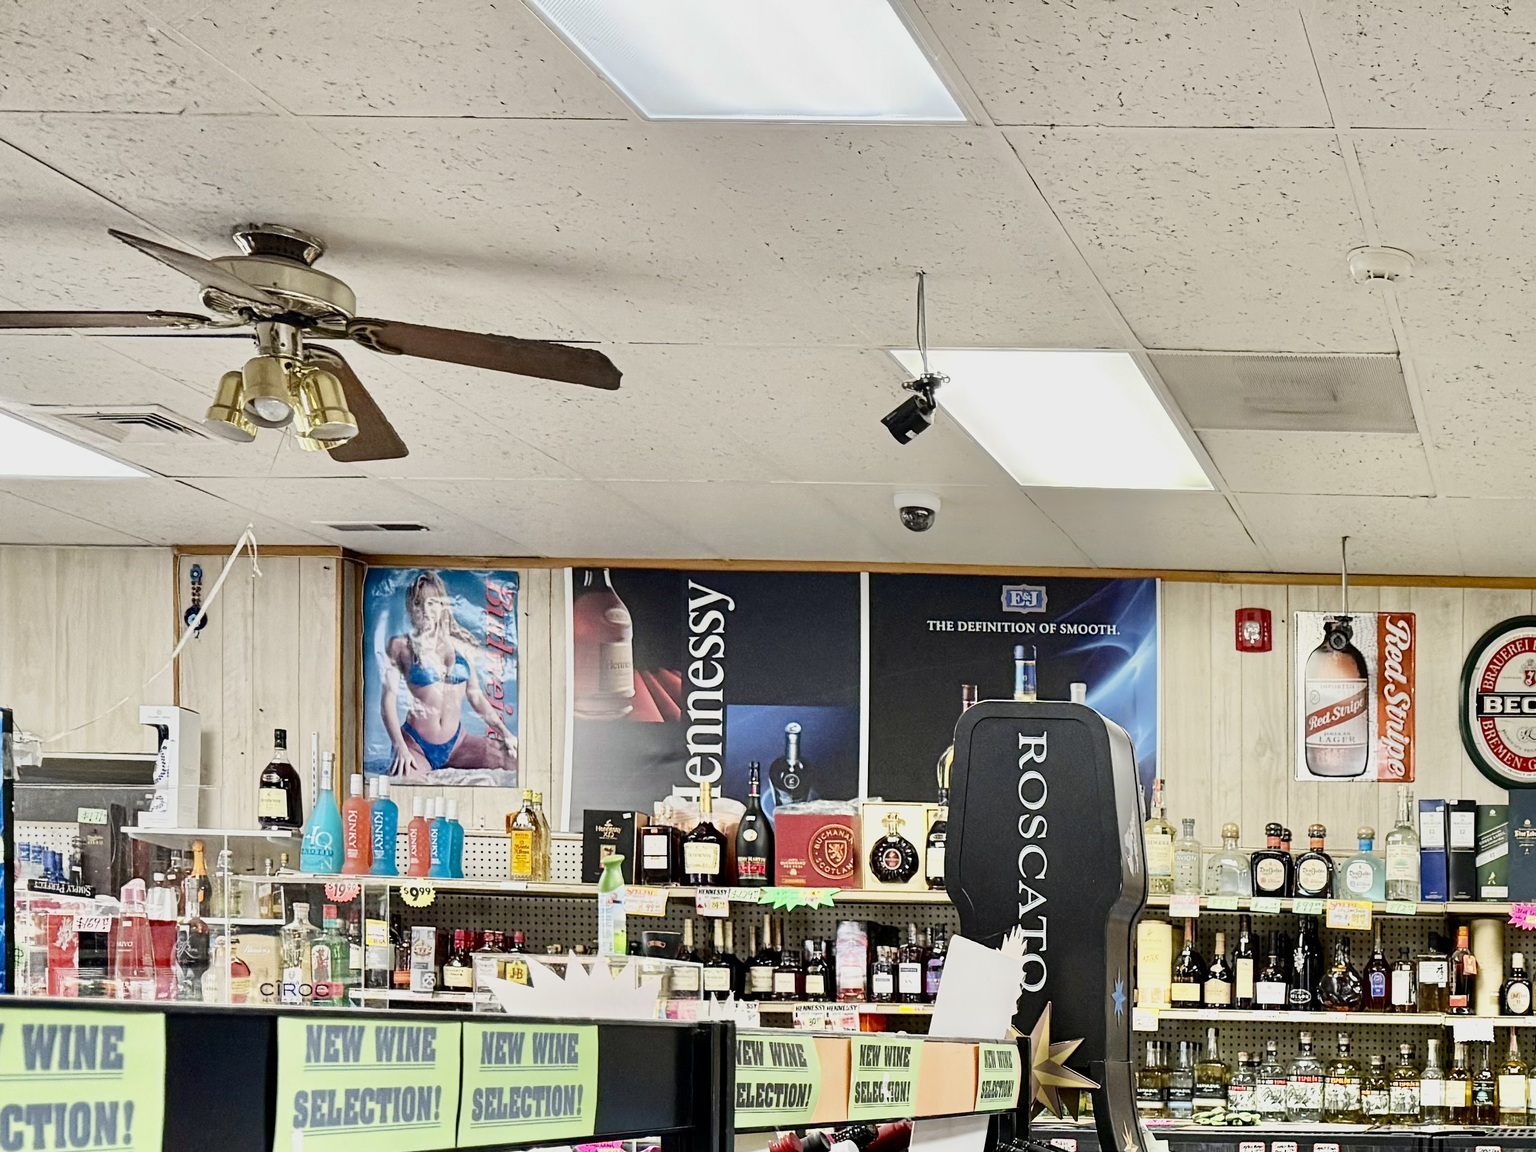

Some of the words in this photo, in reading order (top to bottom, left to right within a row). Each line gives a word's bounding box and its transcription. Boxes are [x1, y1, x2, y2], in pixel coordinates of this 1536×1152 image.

[1010, 589, 1040, 607] E&J
[927, 620, 955, 632] THE
[958, 621, 1036, 634] DEFINITION
[1039, 623, 1057, 635] OF
[1059, 623, 1121, 636] SMOOTH.
[1385, 615, 1412, 683] Red
[1482, 640, 1531, 691] BRAUEREI
[1309, 710, 1332, 729] Red
[1383, 683, 1411, 780] Stripe
[348, 810, 358, 849] KINKY
[374, 811, 384, 849] KINKY
[1015, 731, 1049, 995] ROSCATO
[698, 888, 727, 896] HENNESSY
[22, 1024, 125, 1072] WINE
[305, 1024, 366, 1064] NEW
[374, 1026, 437, 1063] WINE
[480, 1029, 526, 1066] NEW
[531, 1031, 579, 1065] WINE
[735, 1041, 764, 1068] NEW
[770, 1043, 807, 1068] WINE
[859, 1045, 881, 1068] NEW
[885, 1045, 911, 1068] WINE
[983, 1049, 997, 1069] NEW
[998, 1050, 1013, 1069] WINE
[293, 1084, 442, 1130] SELECTION!
[471, 1084, 583, 1123] SELECTION!
[736, 1083, 812, 1109] ELECTION!
[980, 1078, 1014, 1100] SELECTION!
[0, 1099, 134, 1152] CTION!
